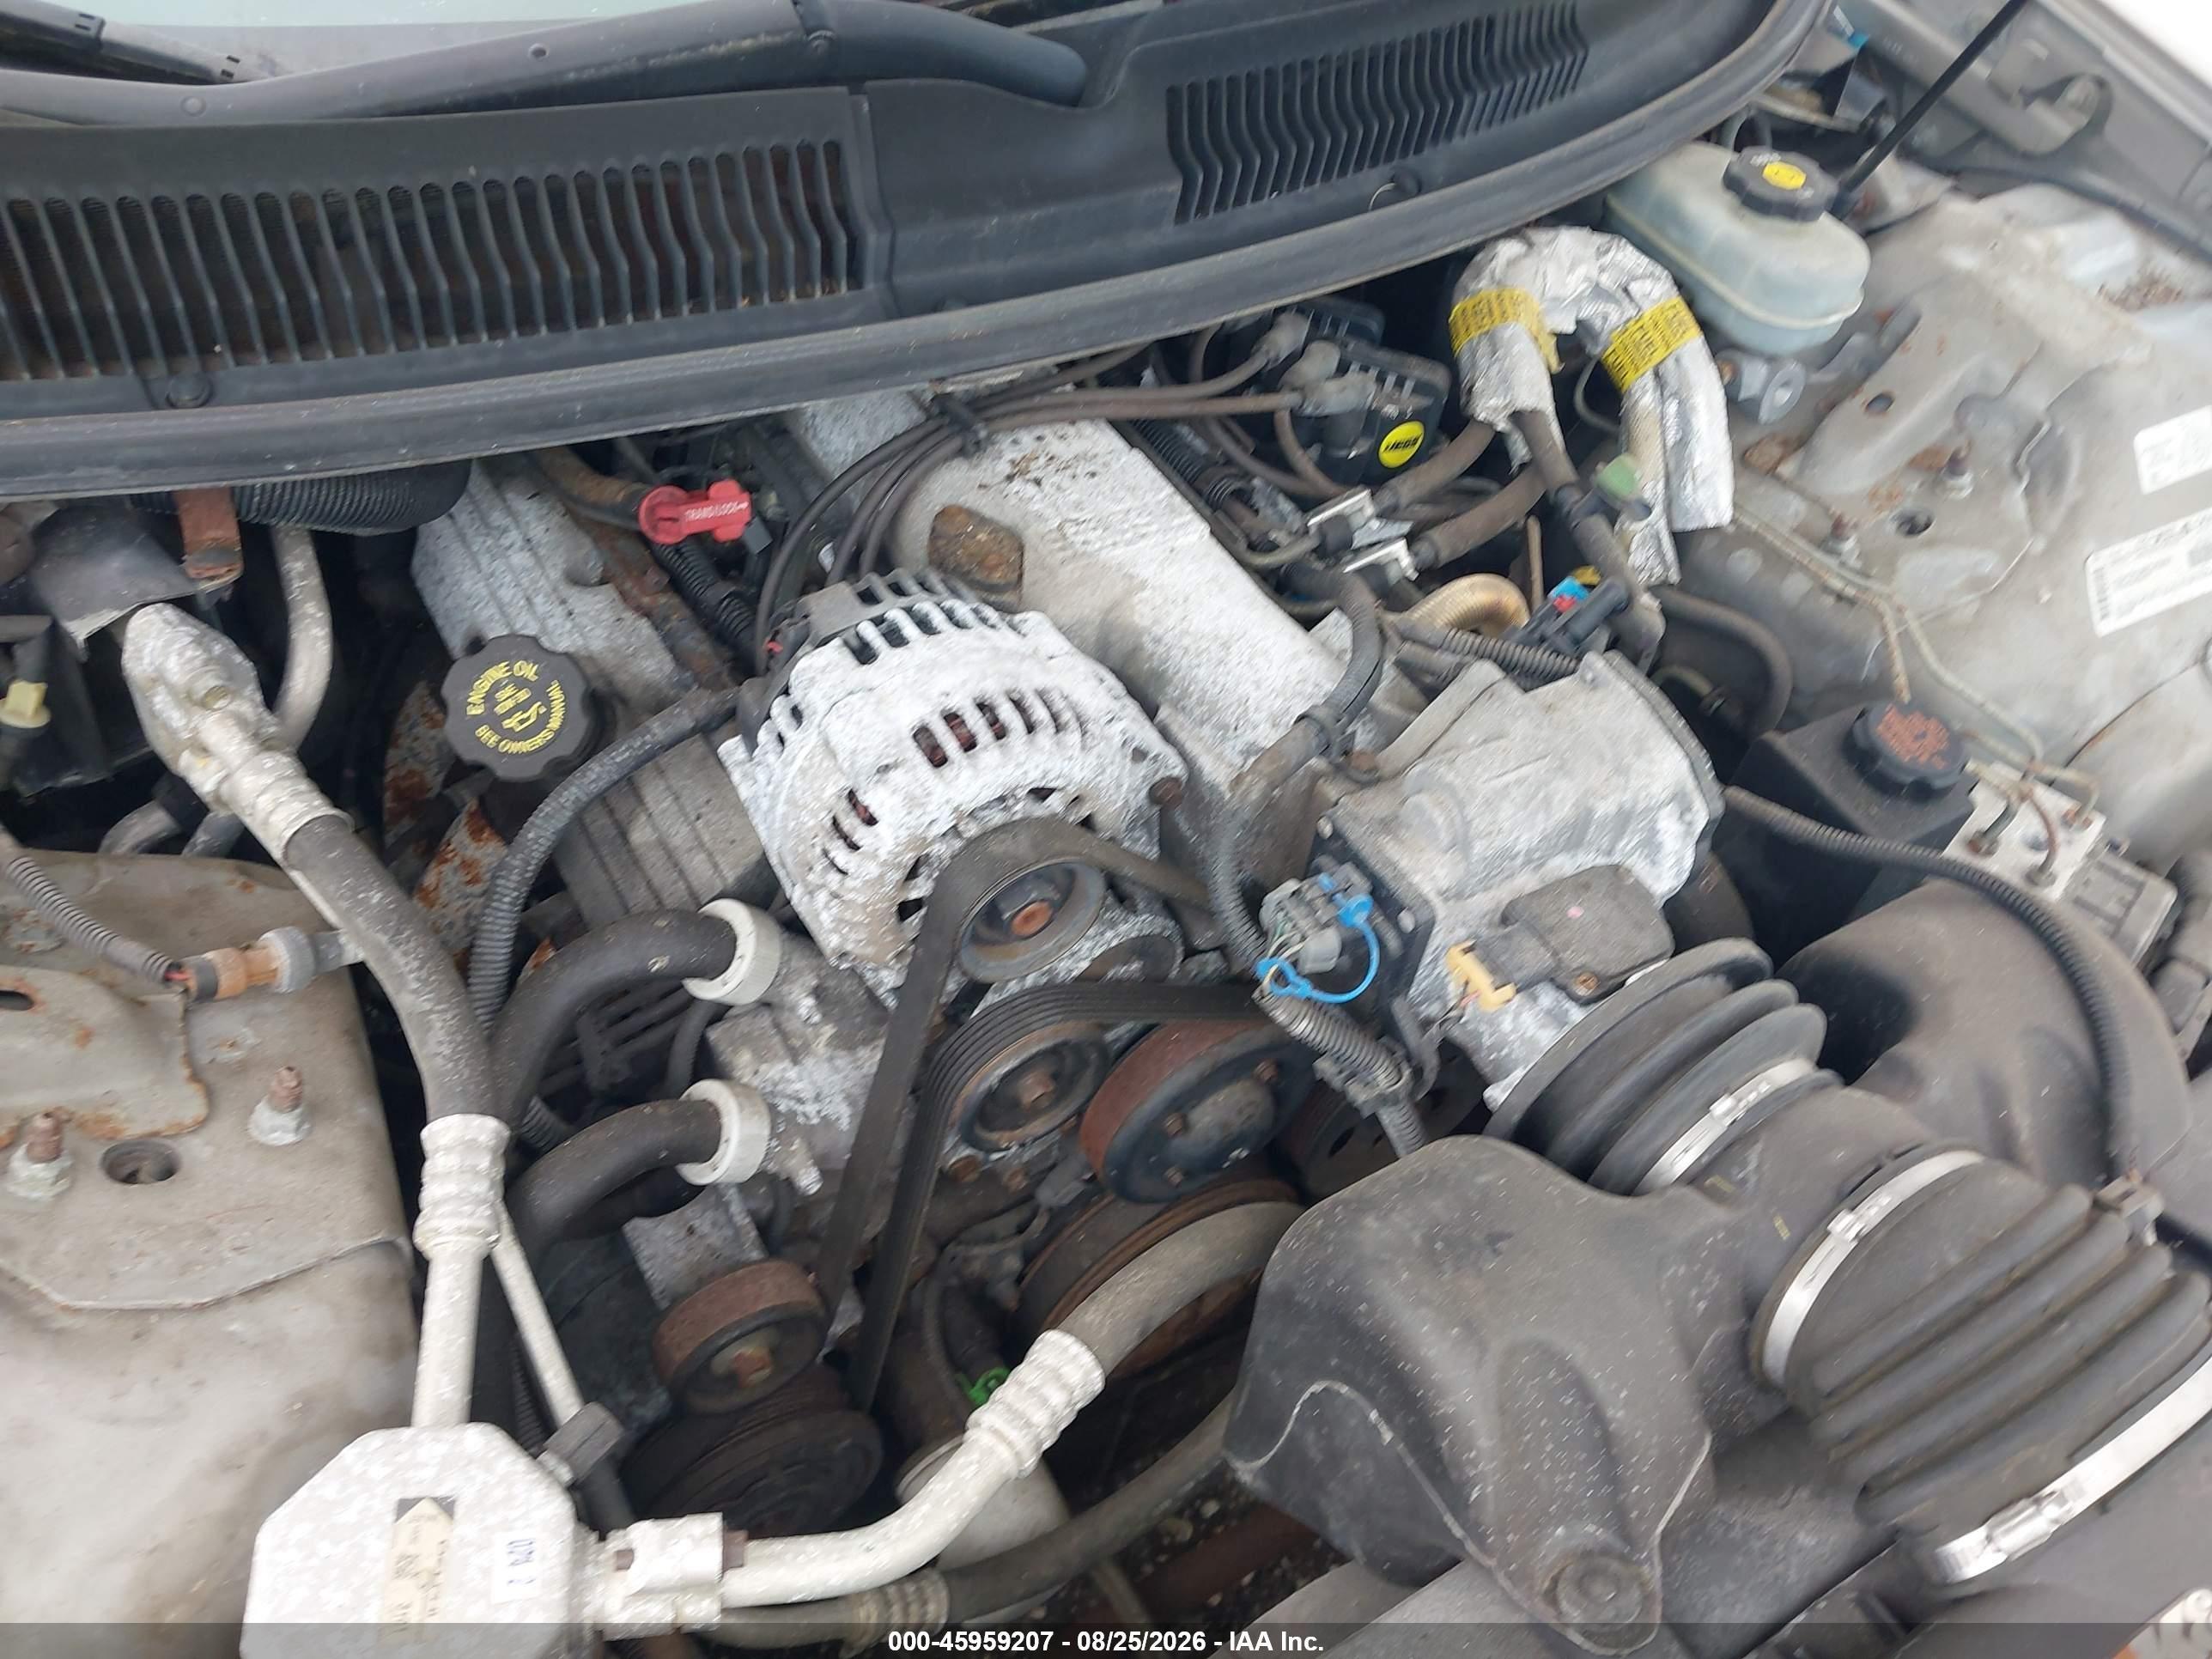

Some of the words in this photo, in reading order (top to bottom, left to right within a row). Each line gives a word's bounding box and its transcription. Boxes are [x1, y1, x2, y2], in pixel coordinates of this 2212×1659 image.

[466, 660, 513, 715] ENGINE
[514, 659, 539, 681] OIL
[475, 724, 501, 749] SEE
